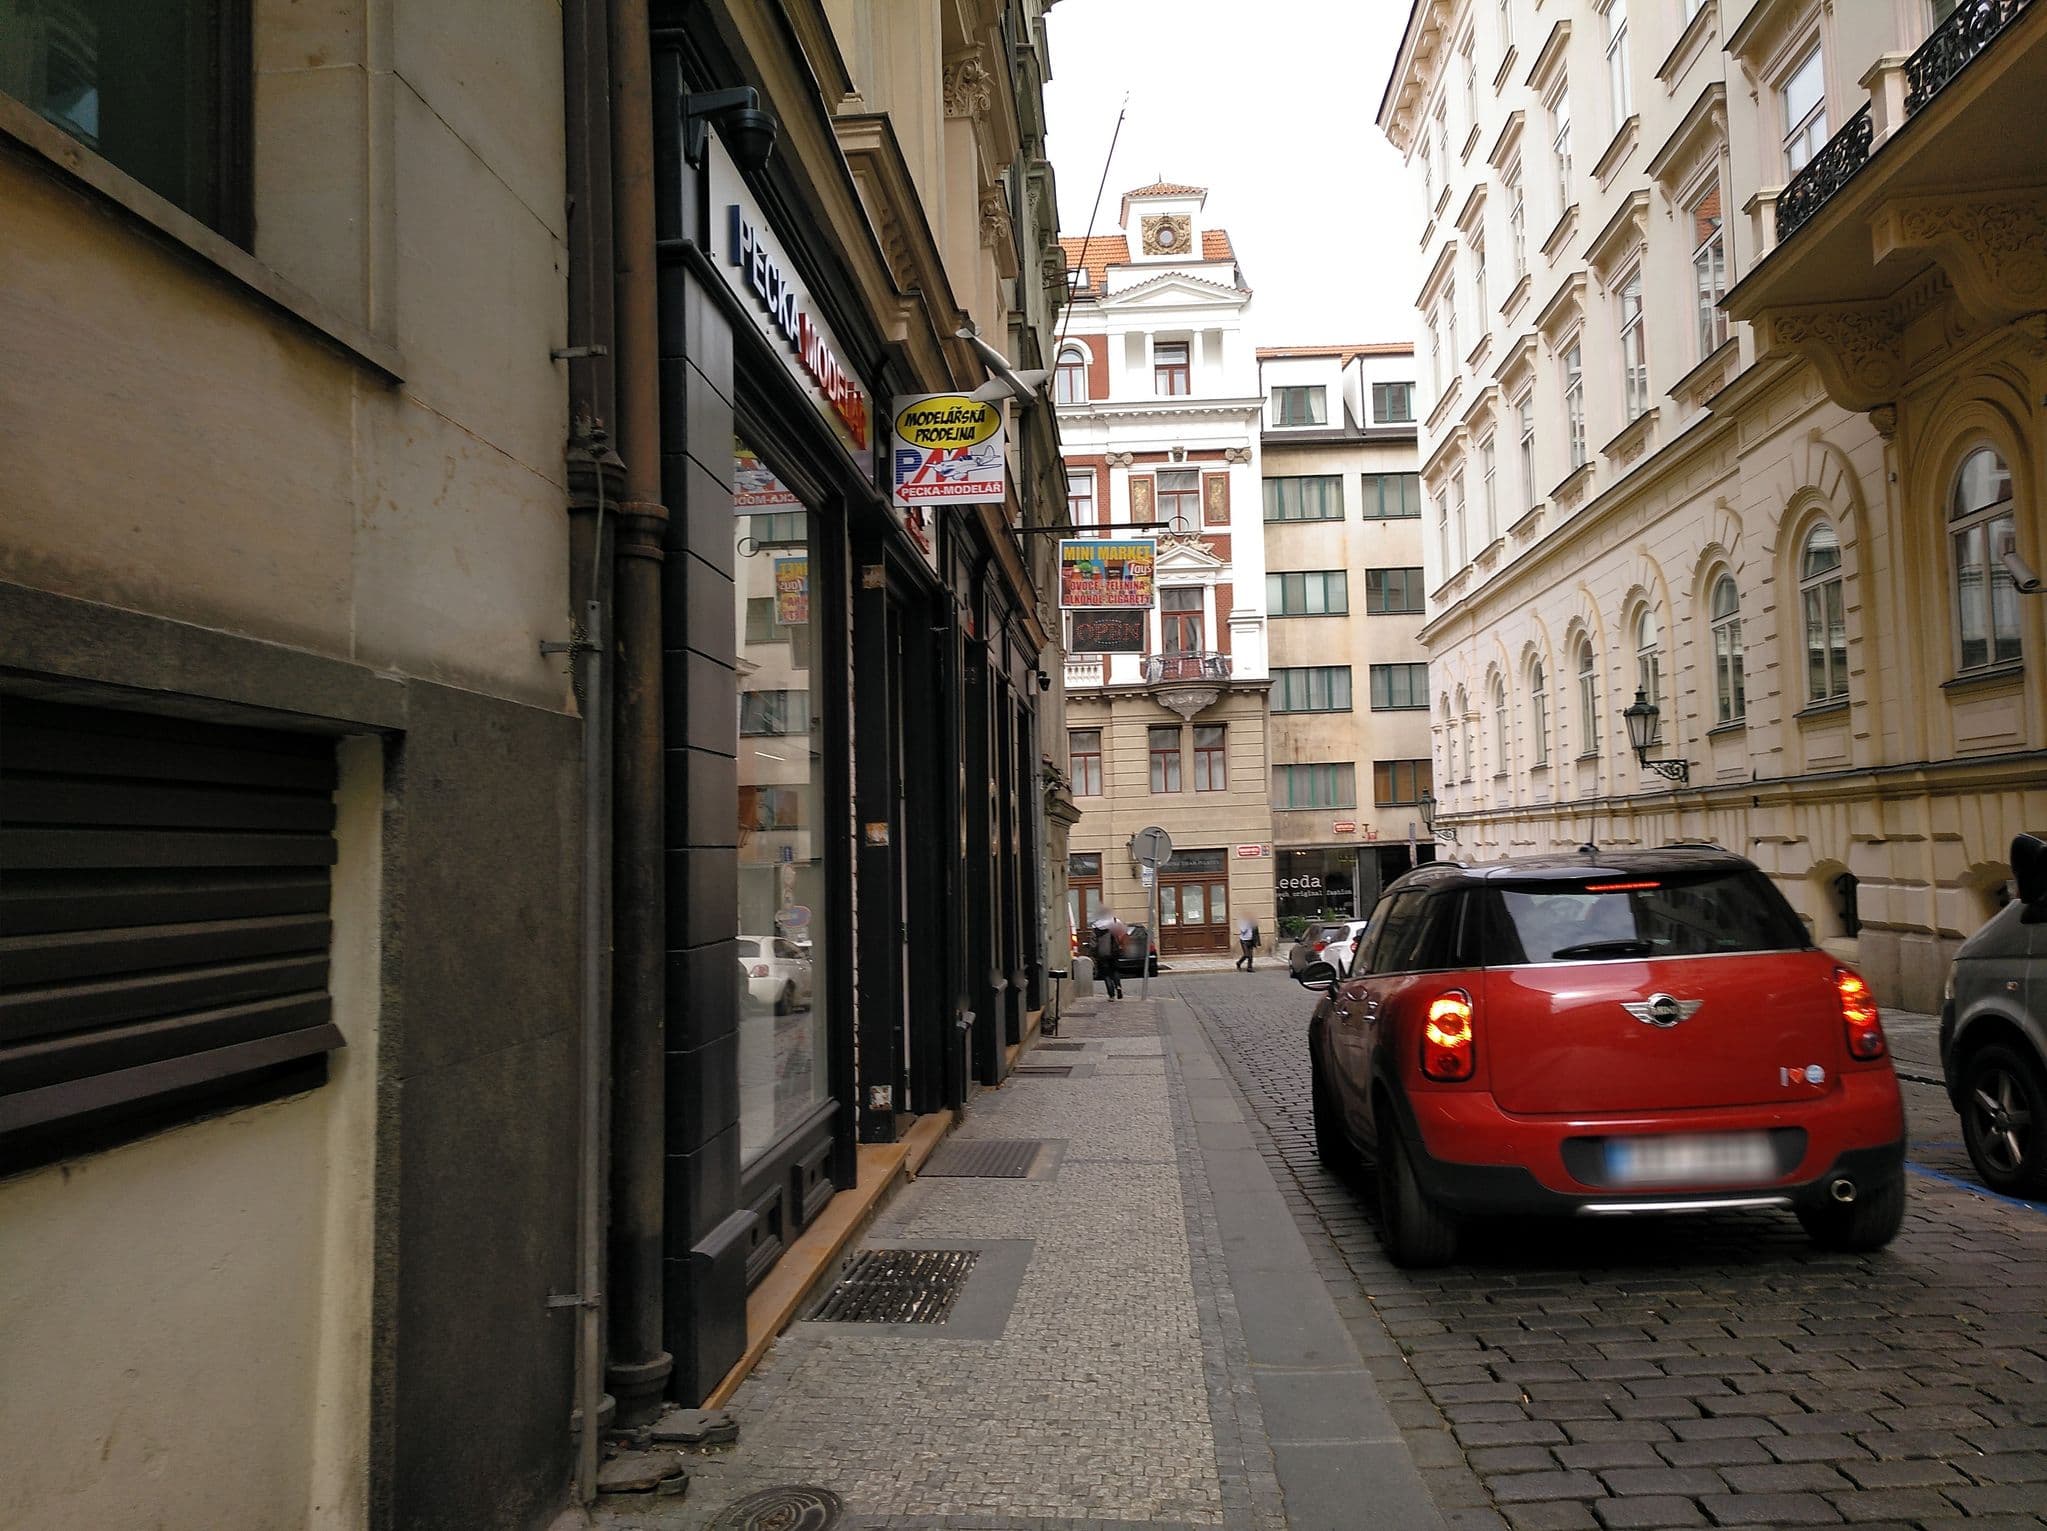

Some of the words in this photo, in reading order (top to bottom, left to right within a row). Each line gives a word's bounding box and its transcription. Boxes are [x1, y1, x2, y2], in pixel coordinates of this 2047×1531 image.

[728, 204, 800, 354] PECKA
[904, 405, 986, 427] MODELÁŘSKÁ
[915, 426, 976, 442] PRODEJNA
[901, 484, 1001, 497] PECKA-MODELÁŘ
[1063, 546, 1094, 561] MINI
[1097, 545, 1151, 561] MARKET
[1071, 581, 1099, 591] OVOCE
[1076, 623, 1141, 641] OPEN
[1275, 874, 1322, 889] eeda
